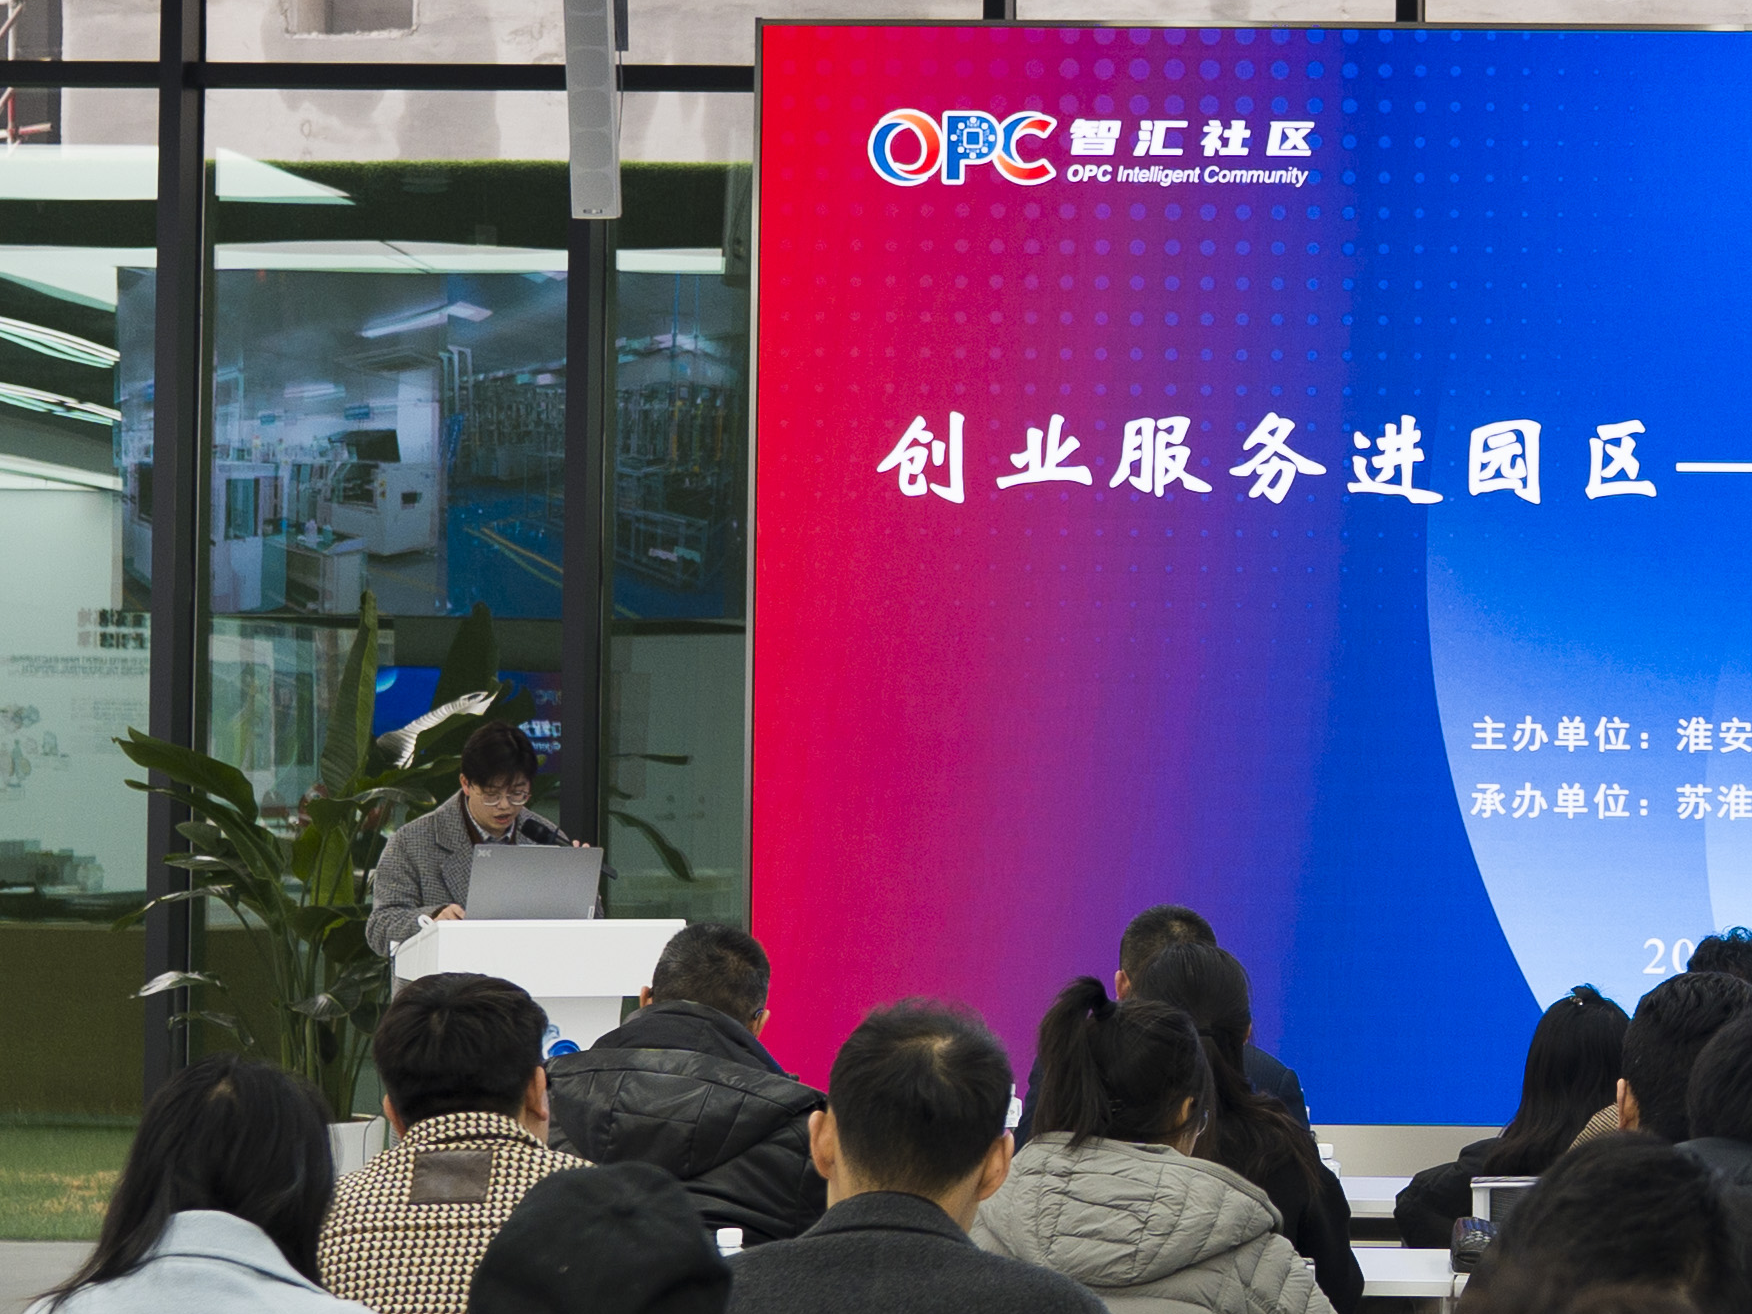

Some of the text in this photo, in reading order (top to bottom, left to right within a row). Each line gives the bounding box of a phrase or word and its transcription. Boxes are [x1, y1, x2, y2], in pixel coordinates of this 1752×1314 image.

[868, 108, 1057, 186] OPC
[1069, 118, 1315, 157] 智汇社区
[1066, 164, 1310, 187] OPC Intelligent Community
